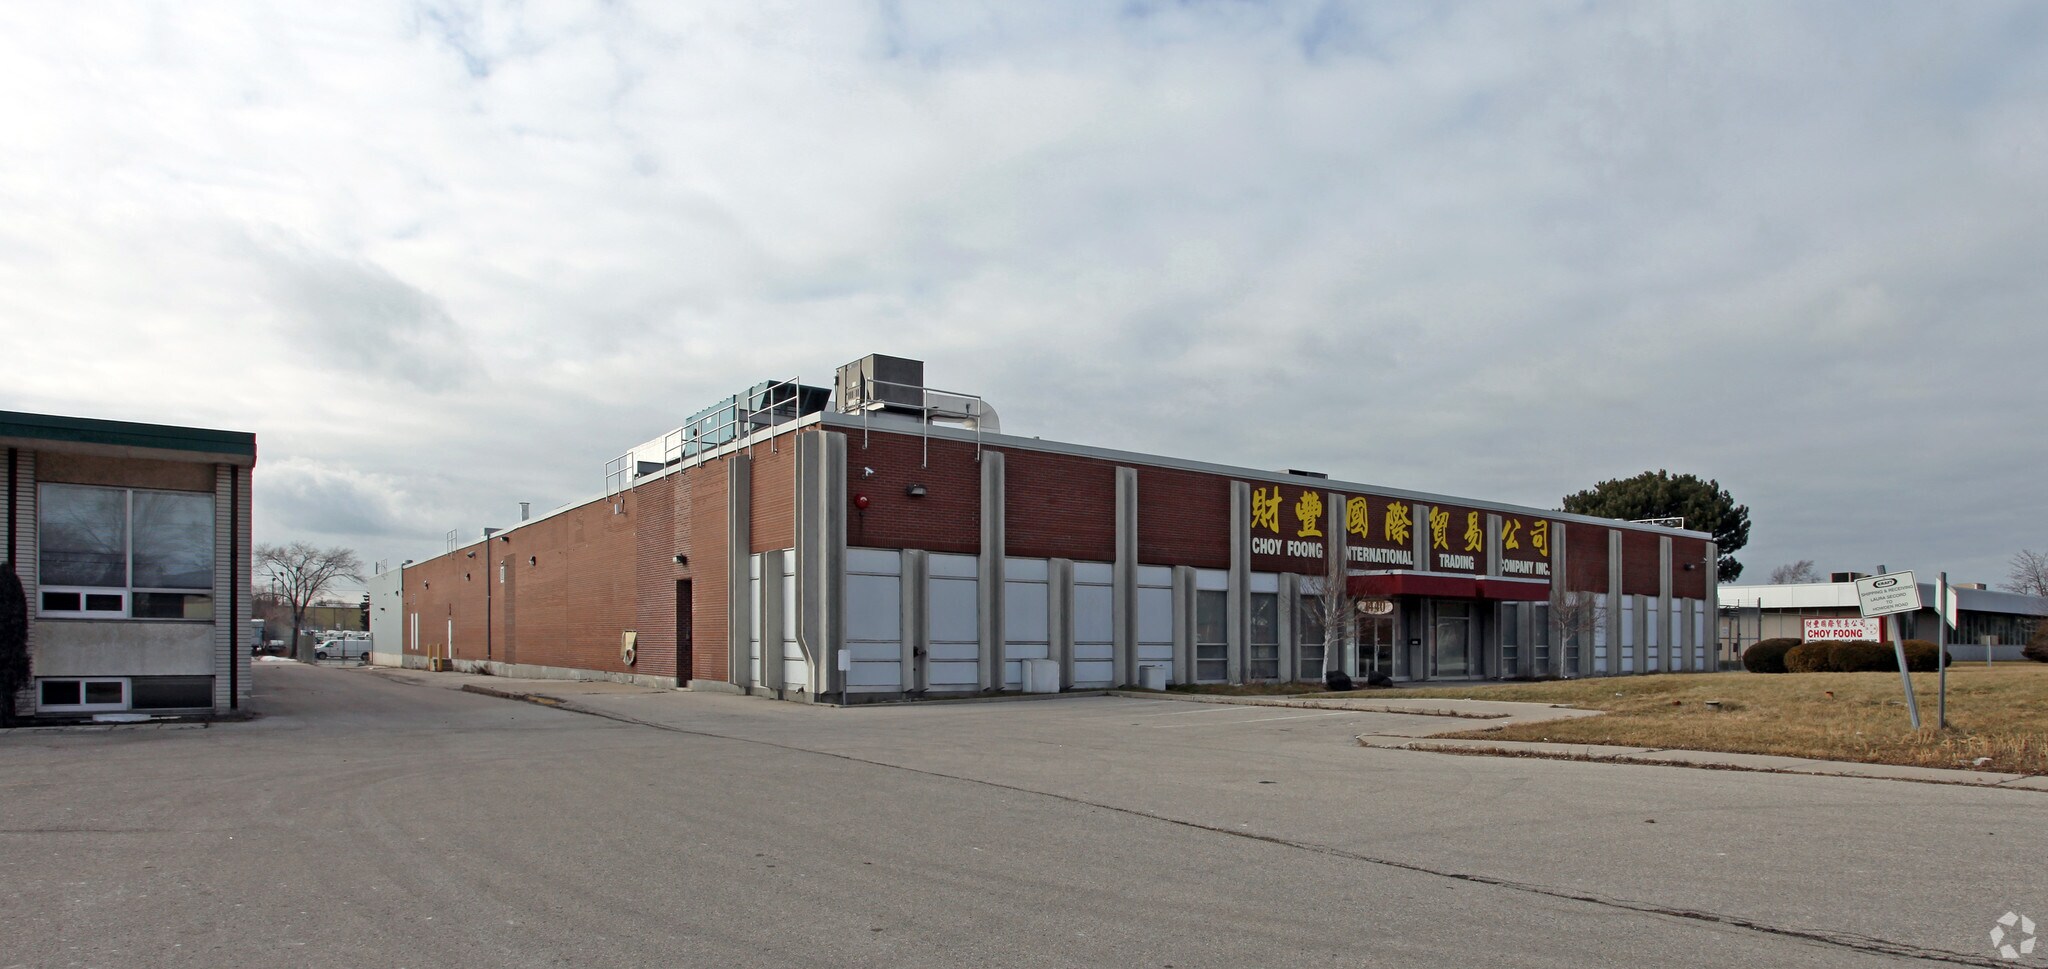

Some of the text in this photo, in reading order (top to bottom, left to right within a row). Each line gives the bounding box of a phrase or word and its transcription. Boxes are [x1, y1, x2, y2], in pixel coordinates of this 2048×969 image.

[1252, 537, 1282, 555] CHOY
[1287, 540, 1323, 558] FOONG
[1345, 546, 1413, 565] NTERNATIONAL
[1439, 553, 1475, 570] TRADING
[1536, 562, 1550, 576] INC.
[1861, 589, 1883, 597] SHIPPING
[1888, 584, 1913, 592] RECEIVING
[1807, 629, 1863, 638] CHOY FOONG
